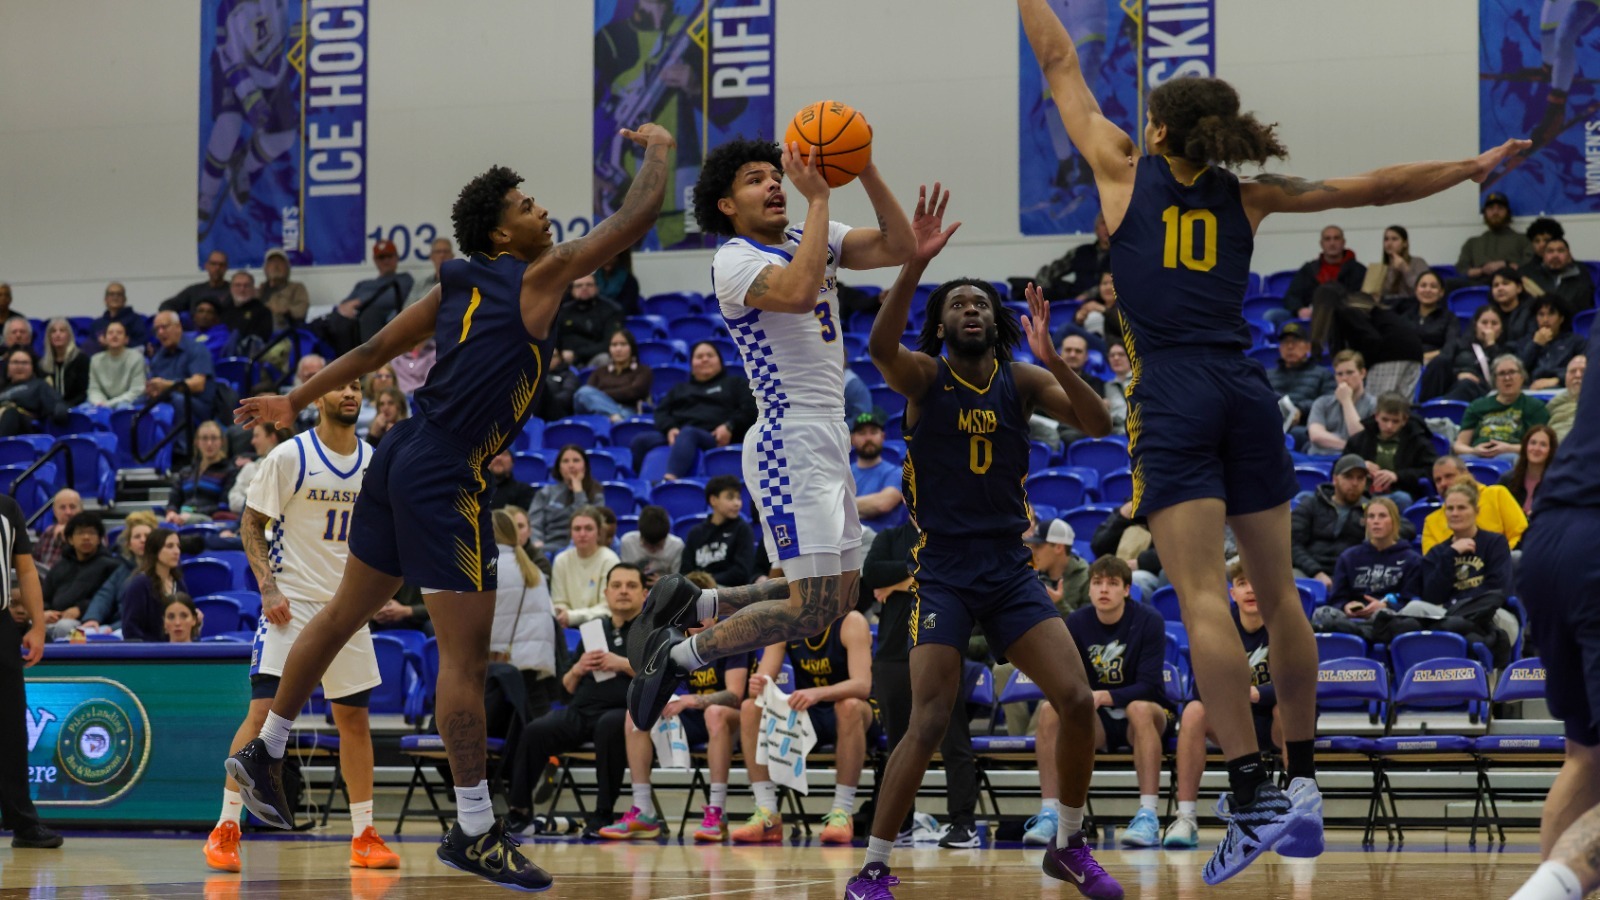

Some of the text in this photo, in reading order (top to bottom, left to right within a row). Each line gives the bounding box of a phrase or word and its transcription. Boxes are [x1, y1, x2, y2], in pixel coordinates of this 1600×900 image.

[1147, 0, 1210, 91] SKI
[308, 0, 364, 197] ICE HOC
[282, 206, 300, 251] MEN'S
[1162, 205, 1217, 272] 10
[458, 287, 481, 344] 1
[814, 301, 837, 344] 3
[969, 434, 993, 475] 0
[322, 508, 351, 542] 11
[1317, 669, 1377, 682] ALASKA
[1413, 667, 1476, 682] ALASKA
